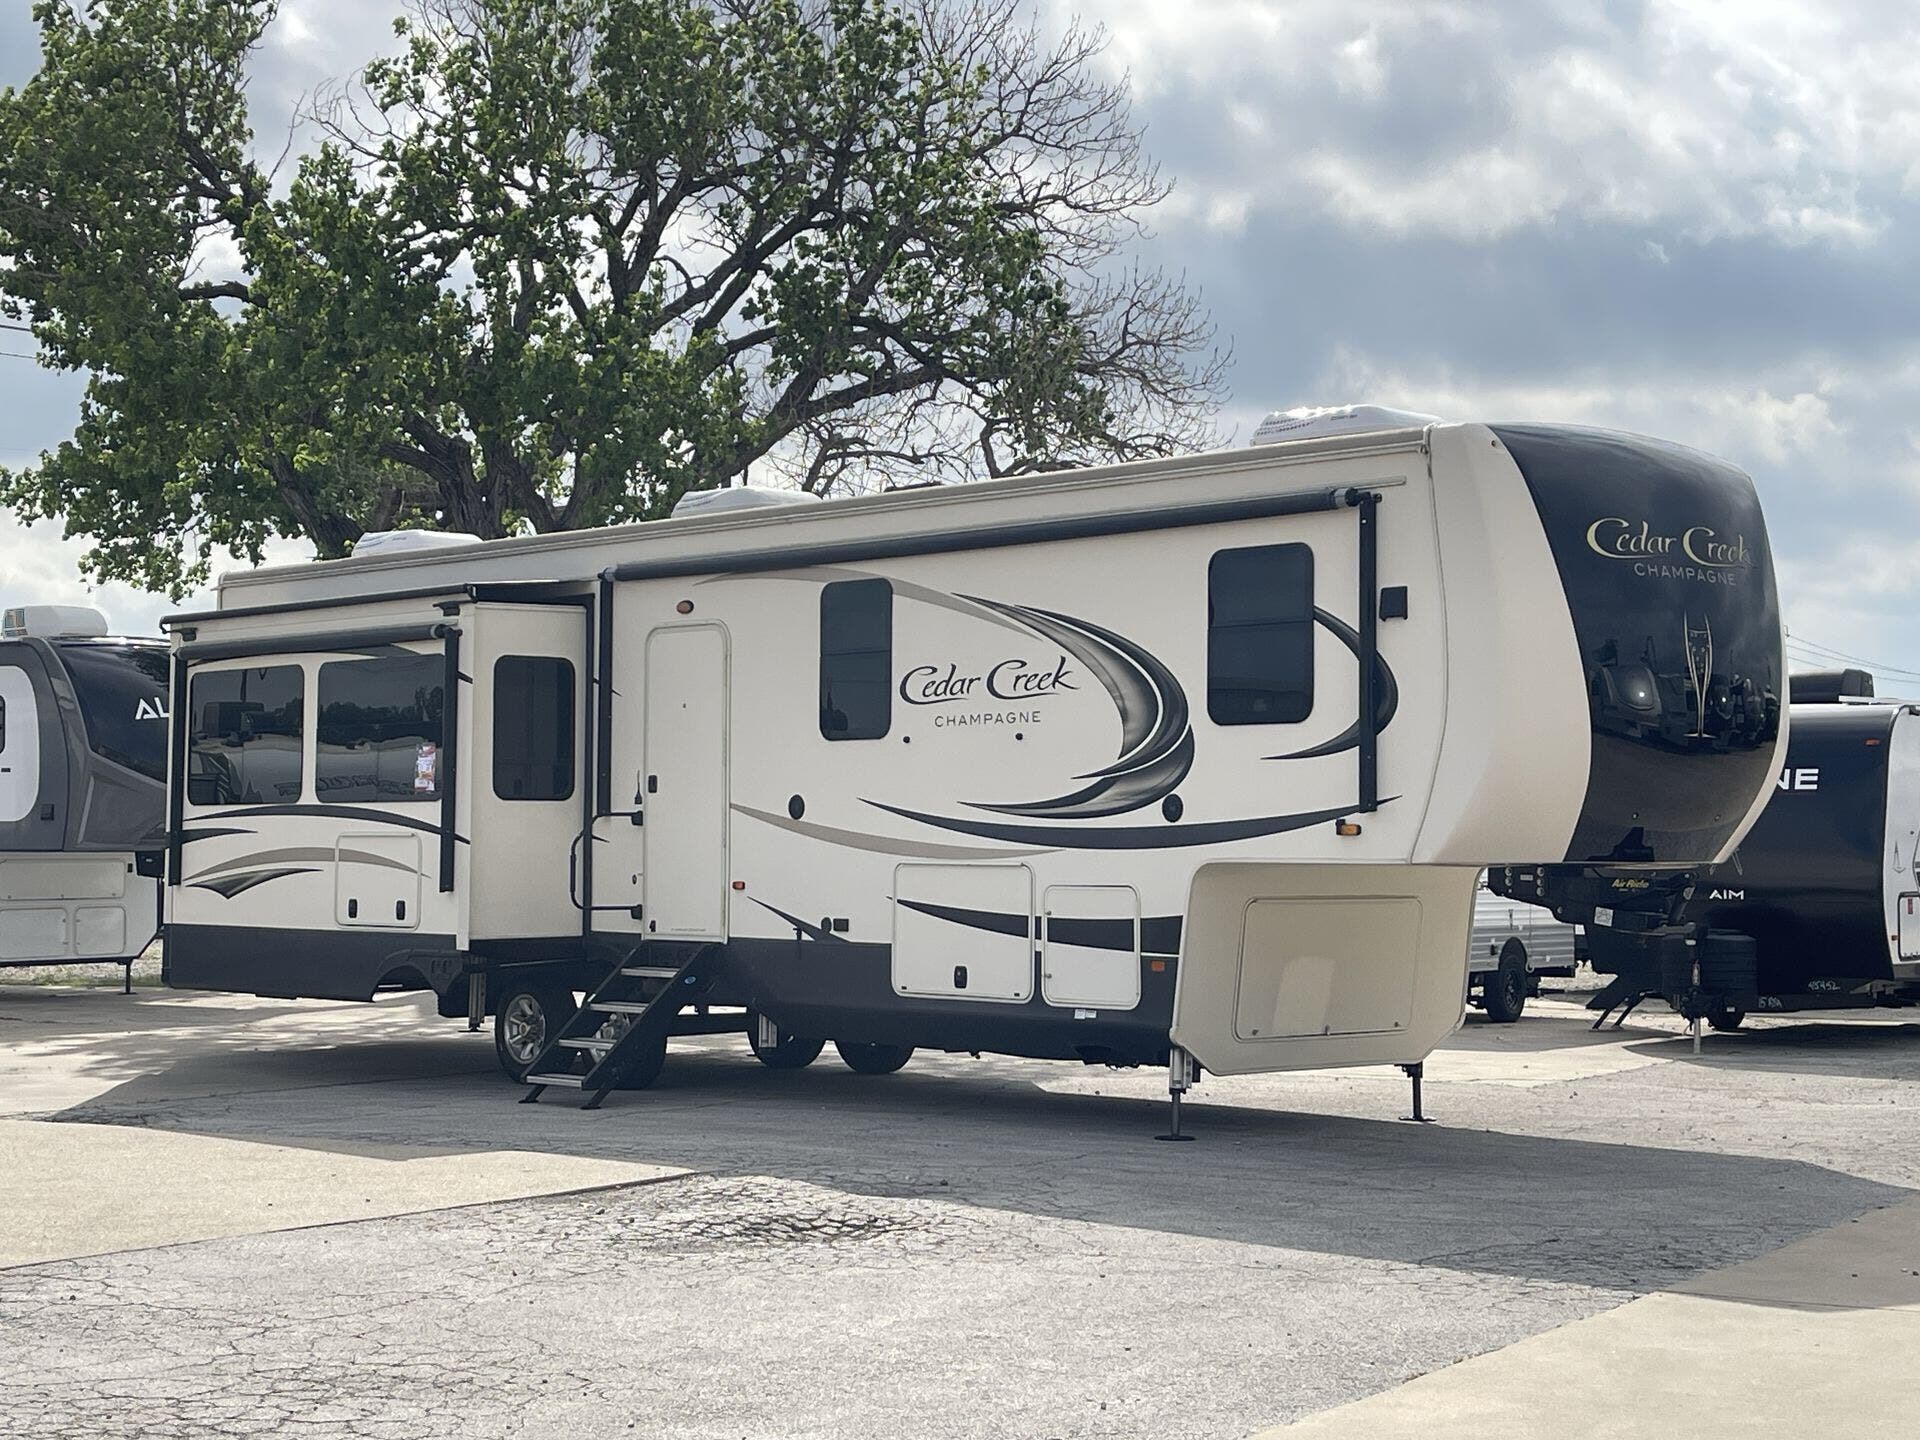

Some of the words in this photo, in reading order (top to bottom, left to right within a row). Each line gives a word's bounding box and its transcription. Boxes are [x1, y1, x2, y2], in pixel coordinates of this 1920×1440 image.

[1586, 517, 1677, 559] Cedar
[1682, 526, 1757, 567] Creek
[1634, 562, 1736, 586] CHAMPAGNE
[899, 663, 981, 705] Cedar
[986, 655, 1081, 700] Creek
[934, 711, 1041, 728] CHAMPAGNE
[1709, 889, 1744, 900] AIM
